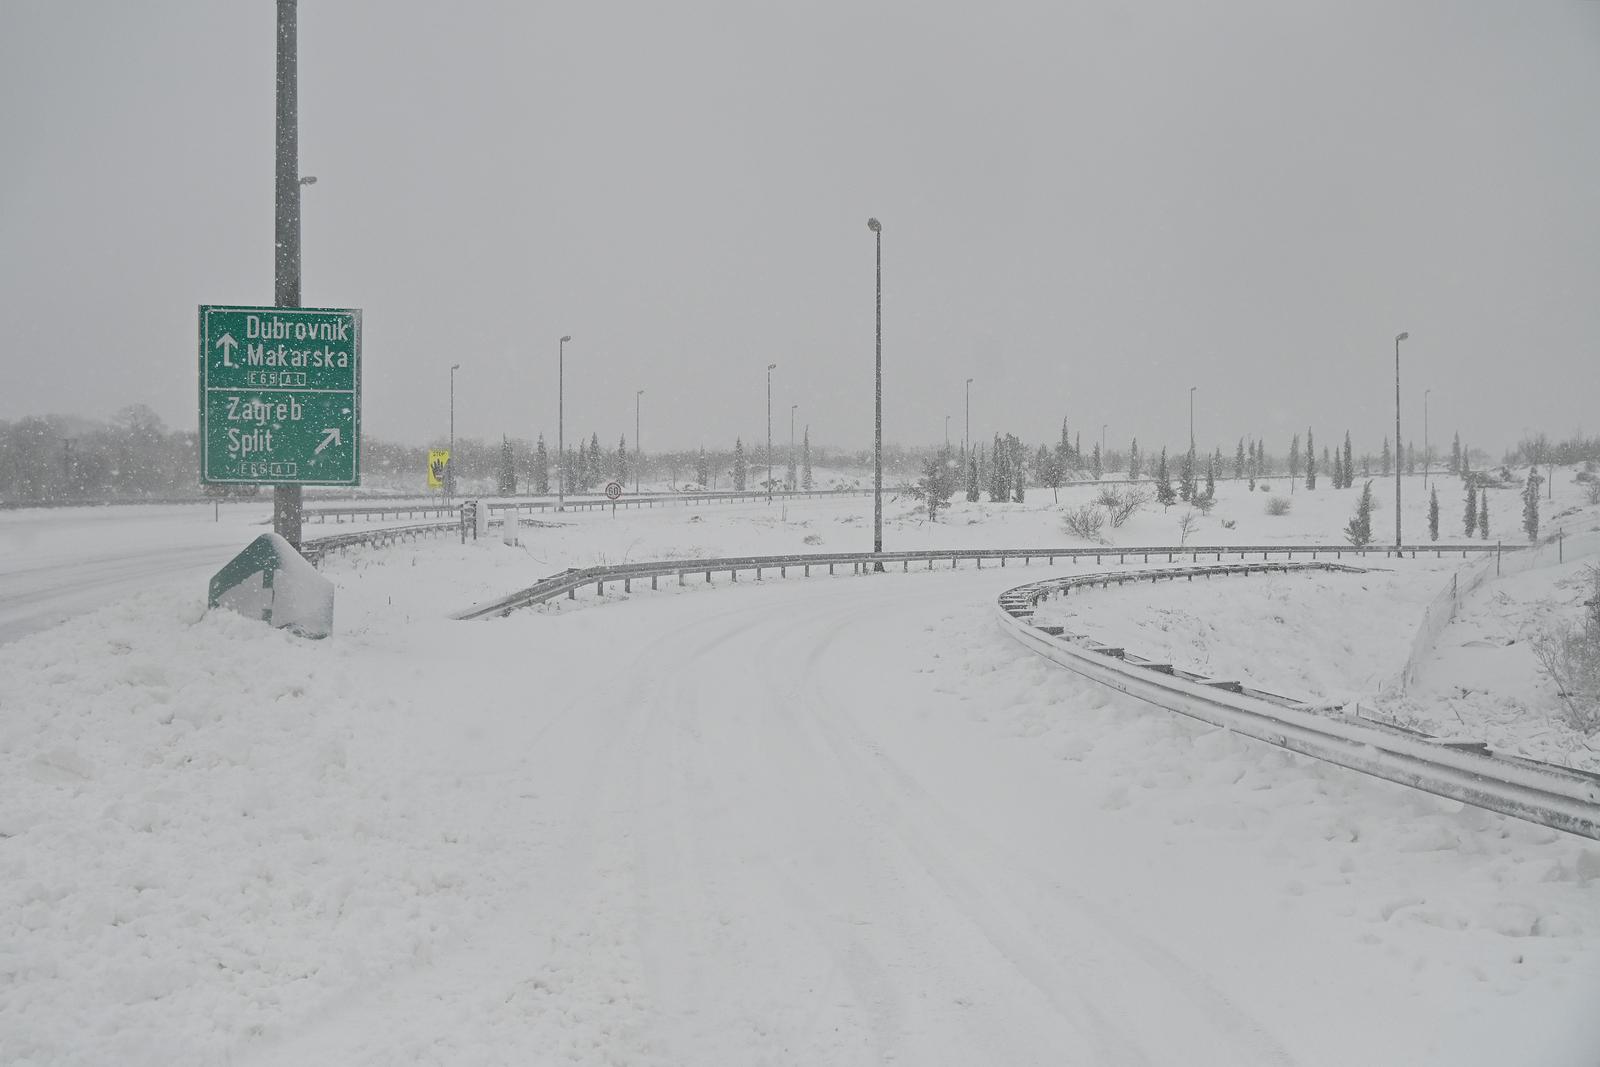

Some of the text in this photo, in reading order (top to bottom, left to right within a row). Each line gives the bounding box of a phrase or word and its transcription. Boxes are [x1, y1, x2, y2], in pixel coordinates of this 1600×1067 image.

[246, 315, 348, 341] Dubrovnik
[247, 343, 348, 368] Makarska
[227, 396, 302, 426] Zagreb
[228, 428, 273, 457] Split
[608, 486, 619, 496] 60
